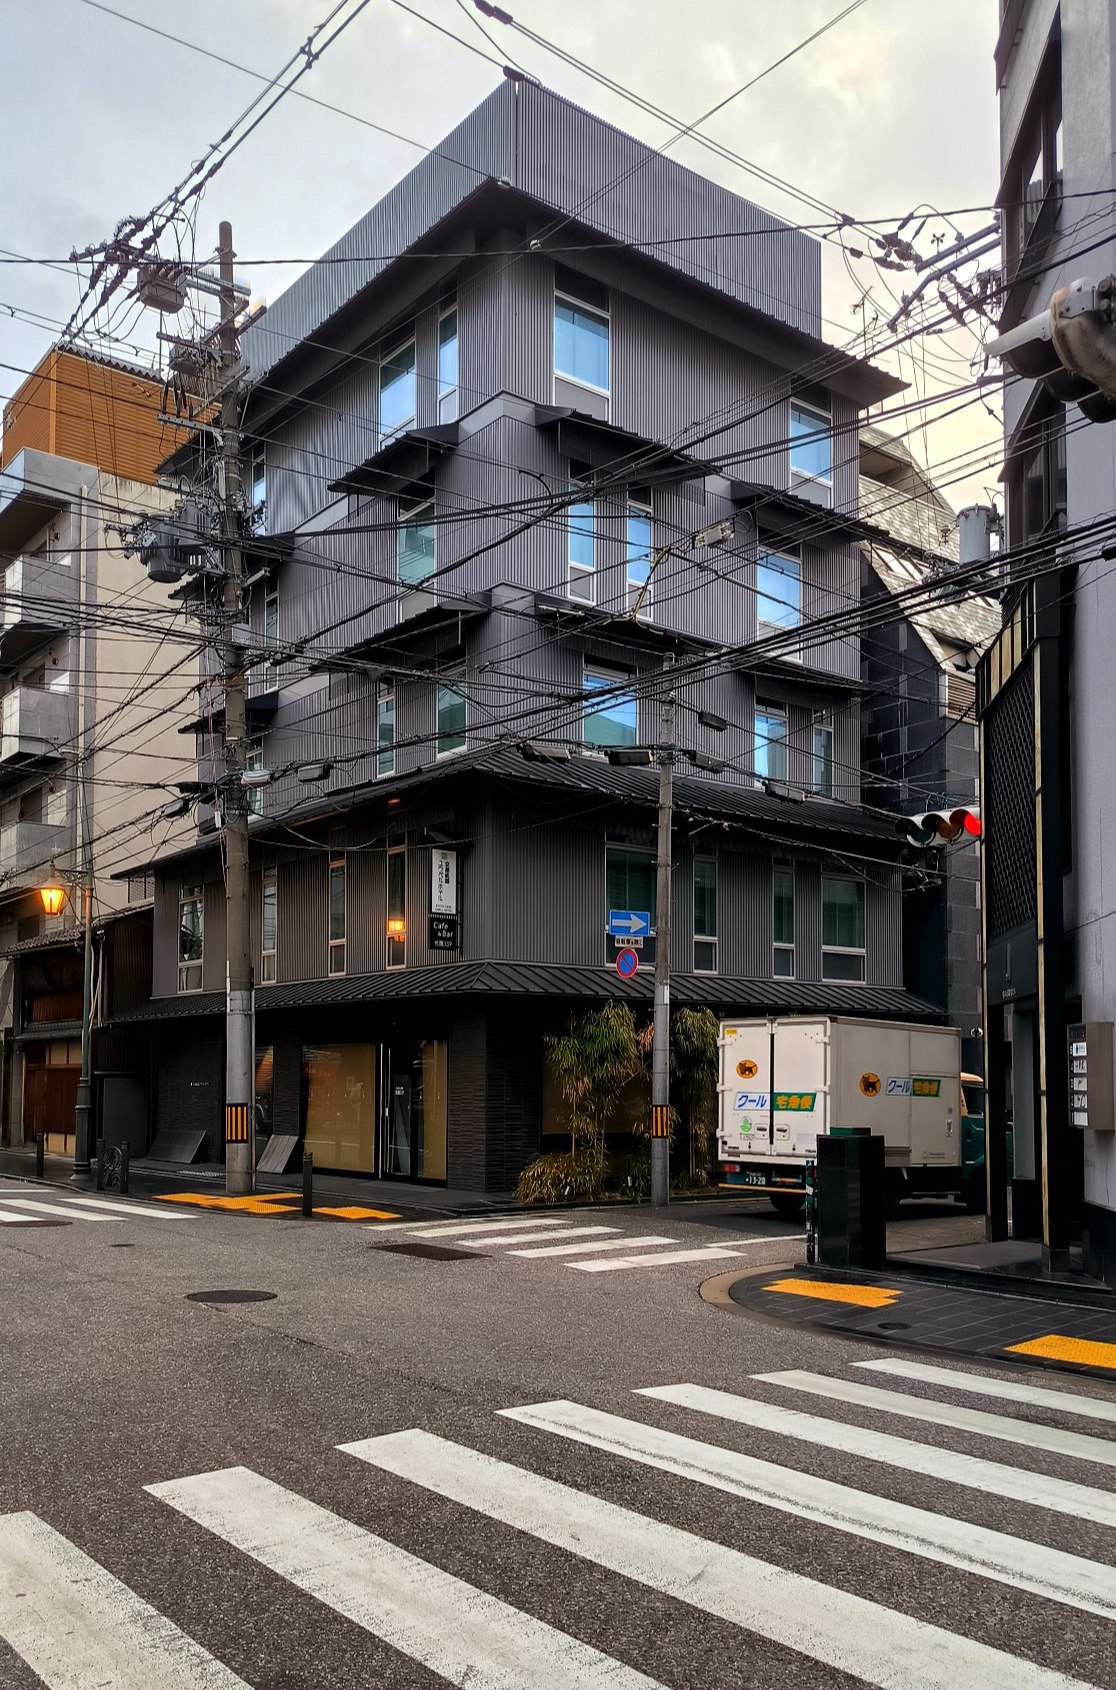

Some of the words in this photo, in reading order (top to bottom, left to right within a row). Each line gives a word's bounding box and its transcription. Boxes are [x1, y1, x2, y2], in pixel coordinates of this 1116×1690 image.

[433, 921, 449, 930] Cafe
[442, 930, 454, 938] Bar
[888, 1080, 910, 1094] クール
[737, 1095, 767, 1108] クール
[776, 1095, 813, 1109] 宅急便
